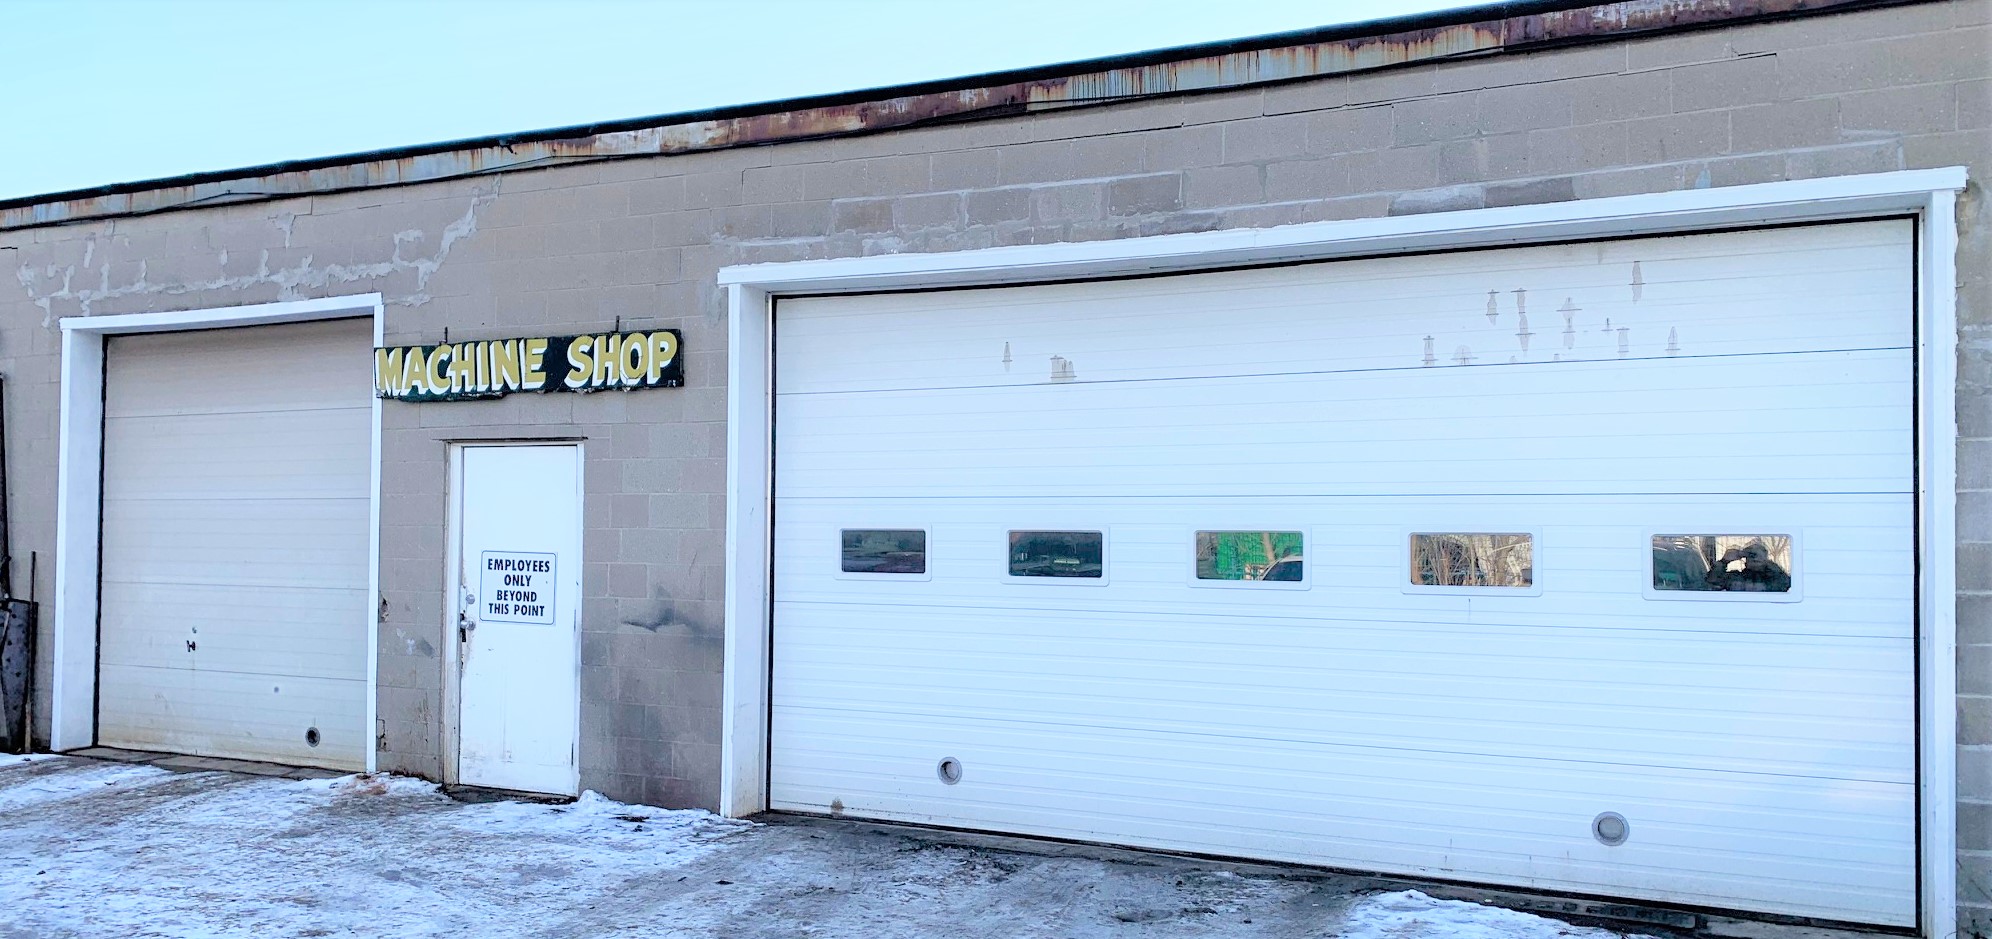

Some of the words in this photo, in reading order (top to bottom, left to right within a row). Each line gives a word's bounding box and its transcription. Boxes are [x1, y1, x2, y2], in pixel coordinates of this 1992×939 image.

[375, 338, 548, 396] MACHINE
[564, 331, 677, 388] SHOP
[487, 558, 550, 573] EMPLOYEES
[504, 574, 532, 587] ONLY
[496, 589, 537, 602] BEYOND
[488, 603, 509, 615] THIS
[514, 604, 545, 616] POINT
